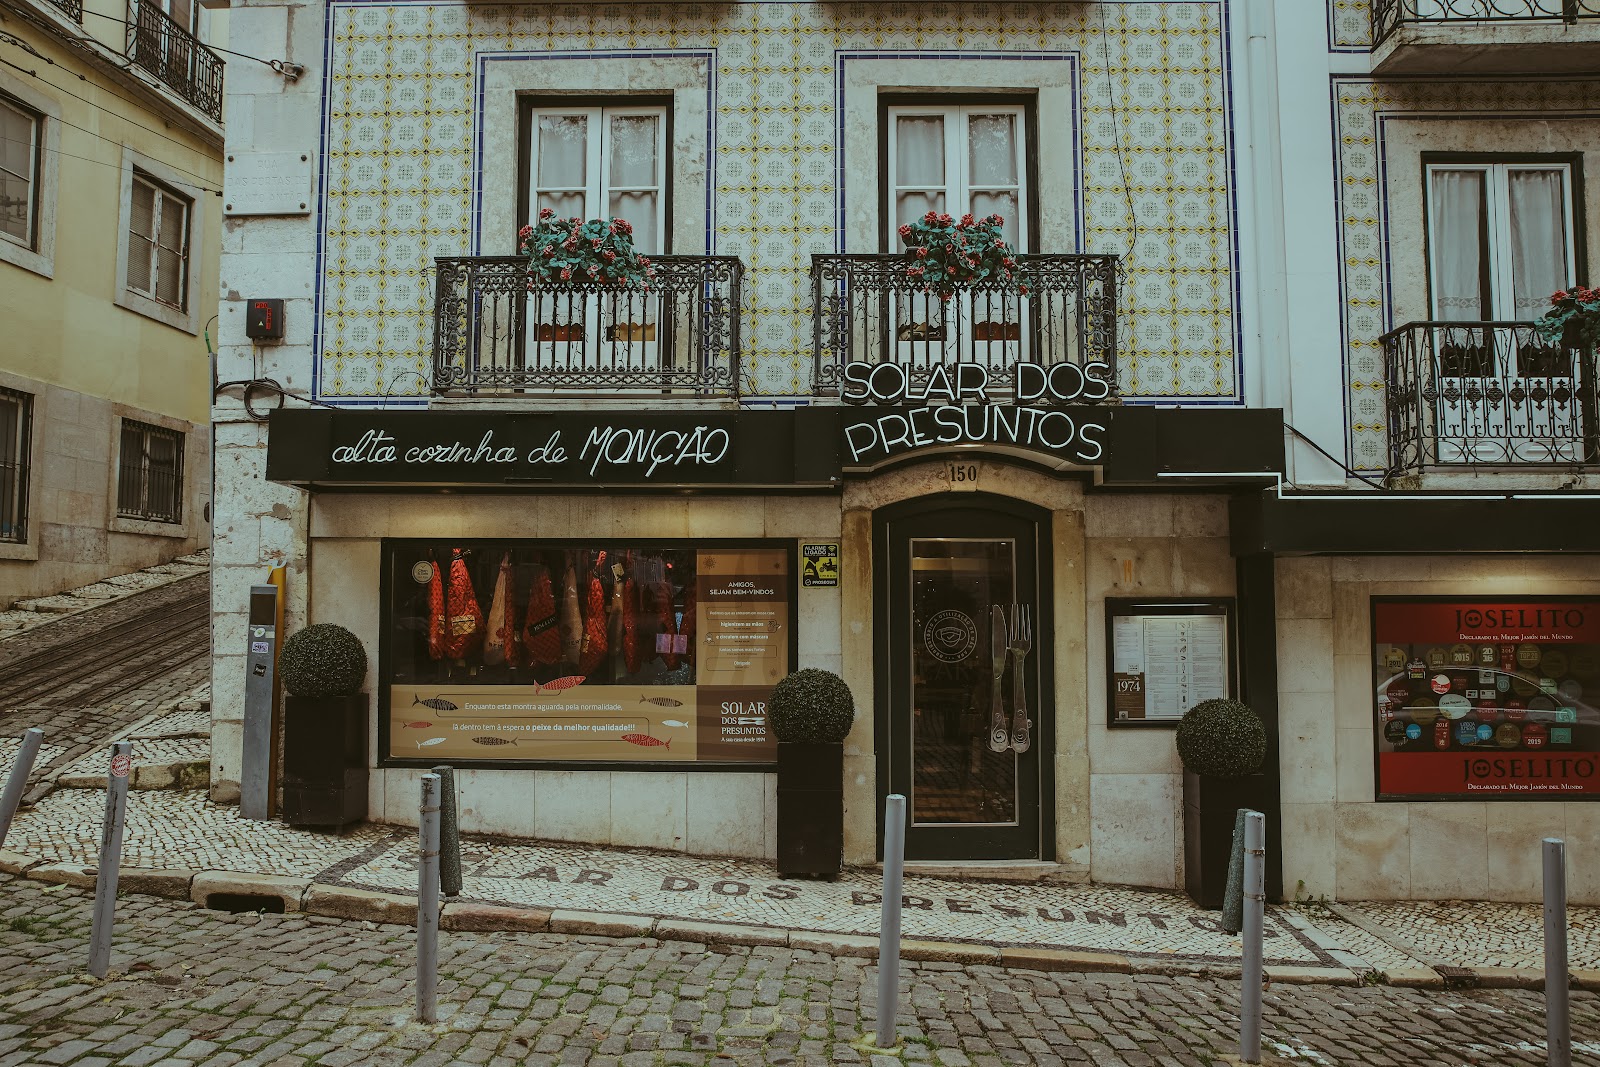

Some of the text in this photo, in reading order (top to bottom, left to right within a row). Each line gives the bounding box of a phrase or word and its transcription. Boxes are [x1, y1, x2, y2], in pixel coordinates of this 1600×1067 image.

[257, 160, 278, 169] RUA
[844, 361, 1110, 400] SOLAR DOS
[844, 405, 1106, 462] PRESUNTOS
[331, 425, 730, 478] alta cozinha de MONÇÃO
[950, 465, 977, 482] 150
[1456, 610, 1584, 632] JOSELITO
[1454, 653, 1470, 661] 2015
[1117, 681, 1140, 692] 1974
[465, 703, 495, 711] Enquanto
[721, 702, 766, 715] SOLAR
[592, 724, 635, 732] qualidade!!!
[1464, 759, 1594, 782] JOSELITO
[660, 876, 802, 900] DOS
